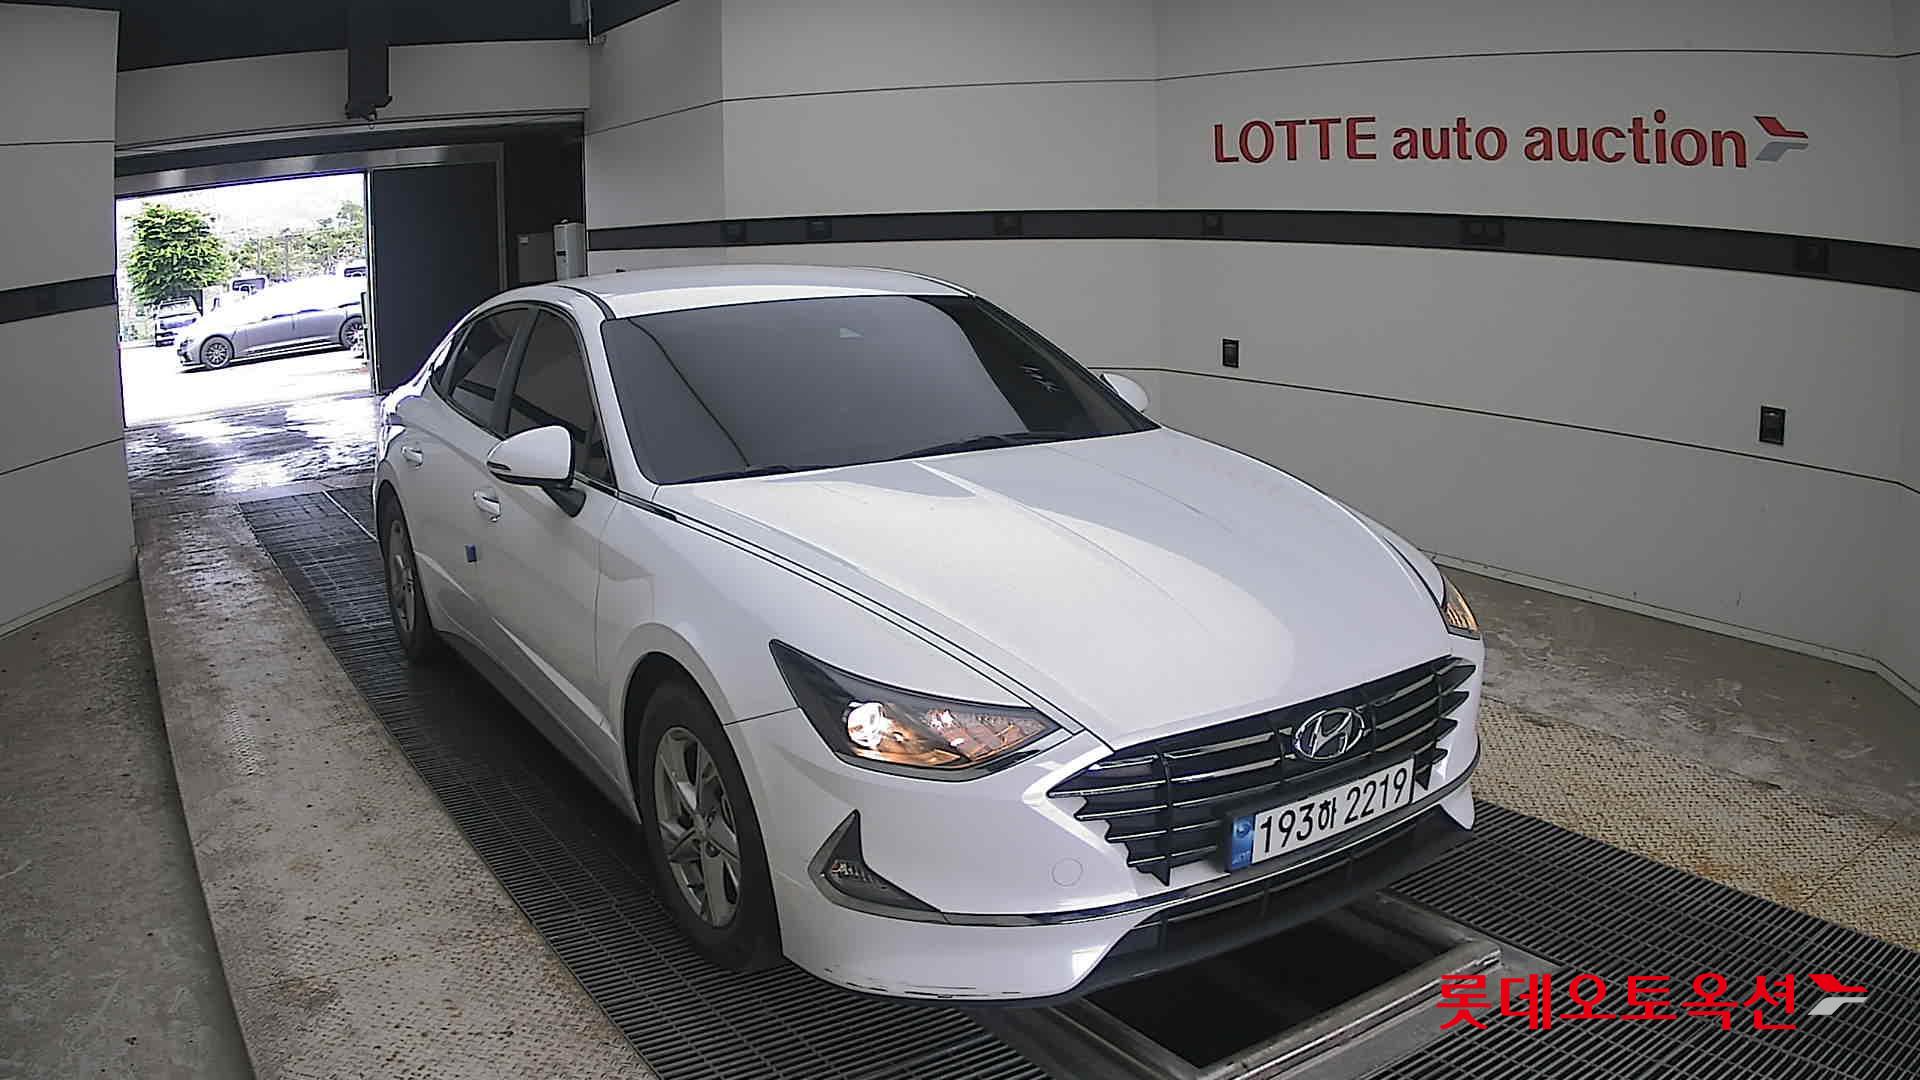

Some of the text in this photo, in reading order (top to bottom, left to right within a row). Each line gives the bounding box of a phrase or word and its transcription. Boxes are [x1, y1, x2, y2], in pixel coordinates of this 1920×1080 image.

[1214, 110, 1748, 168] LOTTE auto auction
[1260, 767, 1408, 853] 193하 2219
